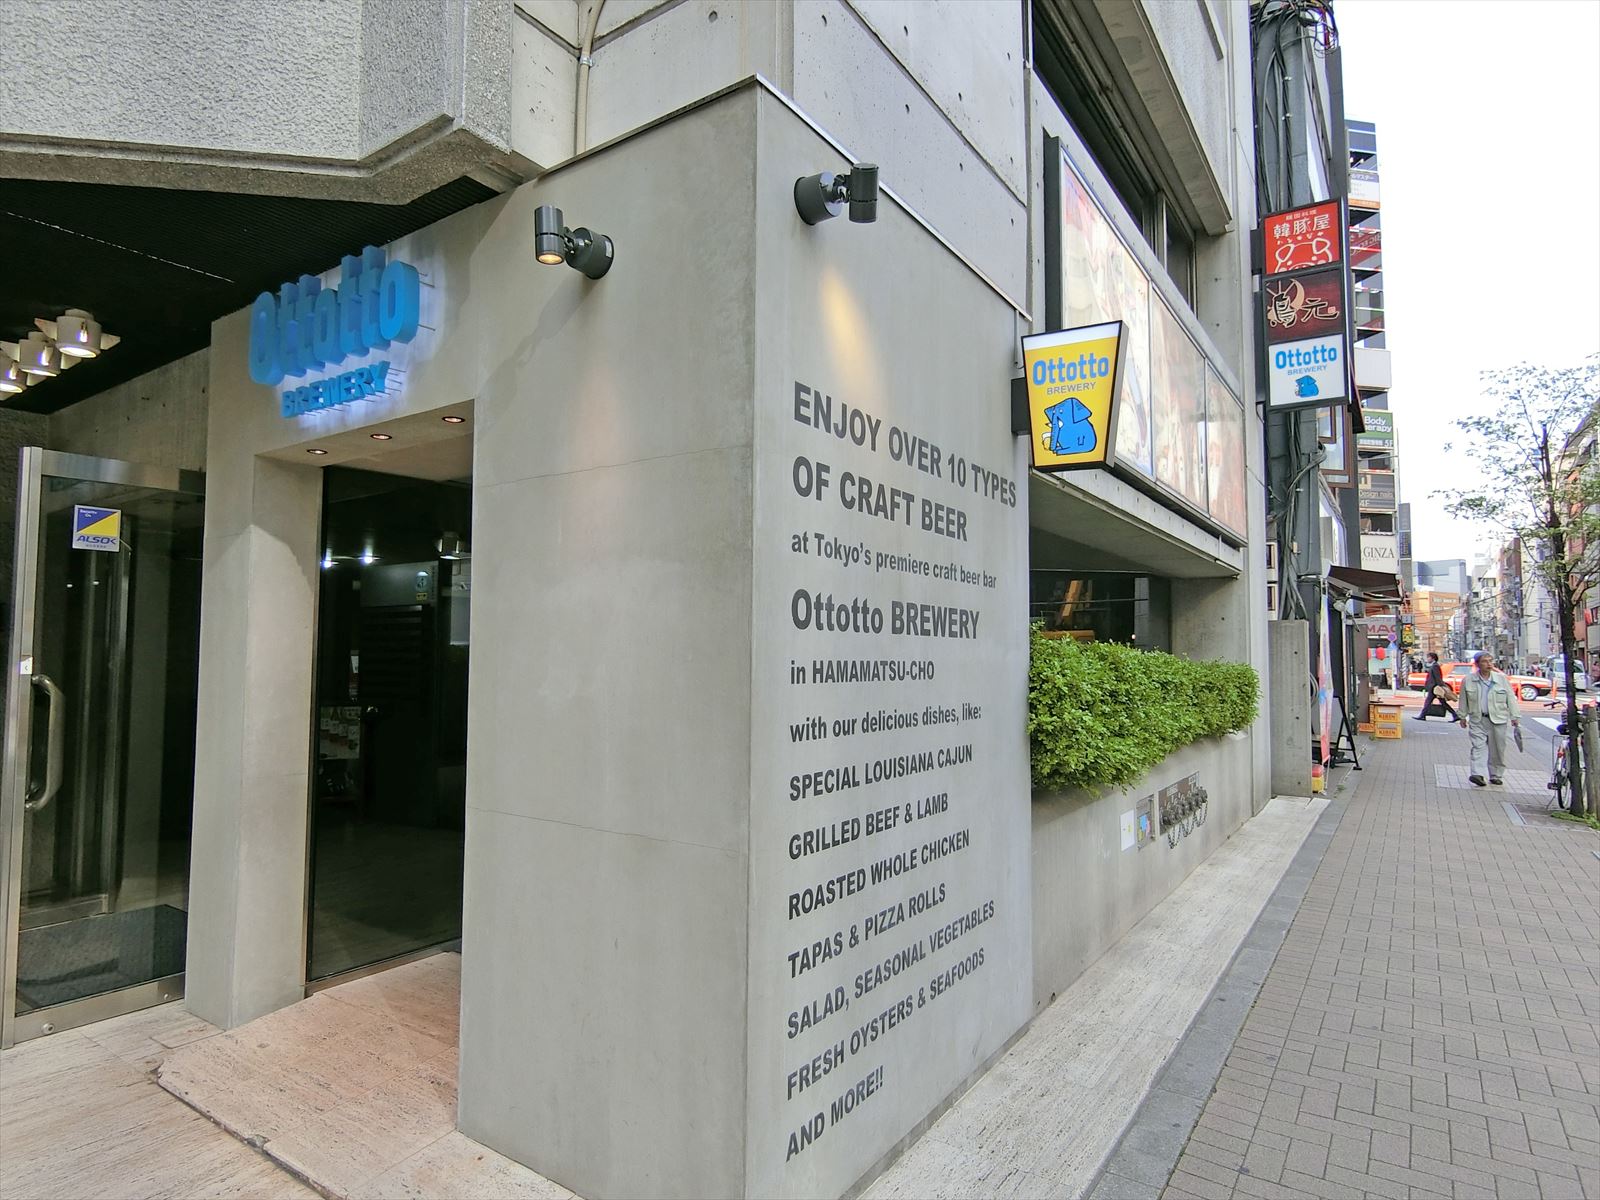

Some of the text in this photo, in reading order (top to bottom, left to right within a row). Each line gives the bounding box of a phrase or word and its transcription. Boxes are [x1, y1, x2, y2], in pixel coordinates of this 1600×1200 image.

[1273, 214, 1330, 239] 韓豚屋
[248, 245, 420, 386] Ottotto
[1033, 353, 1109, 385] Ottotto
[1276, 344, 1337, 369] Ottotto
[1288, 365, 1327, 375] BREWERY
[282, 361, 390, 418] BREWERY
[1047, 382, 1096, 395] BREWERY
[794, 381, 1016, 508] ENJOY OVER 10 TYPES
[1365, 416, 1386, 425] Body
[793, 456, 967, 541] OF CRAFT BEER
[792, 531, 996, 589] at Tokyo's premiere craft beer bar
[1363, 547, 1394, 558] GINZA
[792, 589, 979, 639] Ottotto BREWERY
[791, 660, 935, 685] in HAMAMATSU-CHO
[790, 704, 981, 743] with our delicious dishes, like:
[789, 744, 972, 801] SPECIAL LOUISIANA CAJUN
[789, 793, 948, 860] GRILLED BEEF & LAMB
[789, 829, 969, 920] ROASTED WHOLE CHICKEN
[788, 883, 946, 978] TAPAS & PIZZA ROLLS
[788, 900, 994, 1039] SALAD, SEASONAL VEGETABLES
[788, 948, 984, 1100] FRESH OYSTERS & SEAFOODS
[786, 1066, 883, 1162] AND MORE!!
